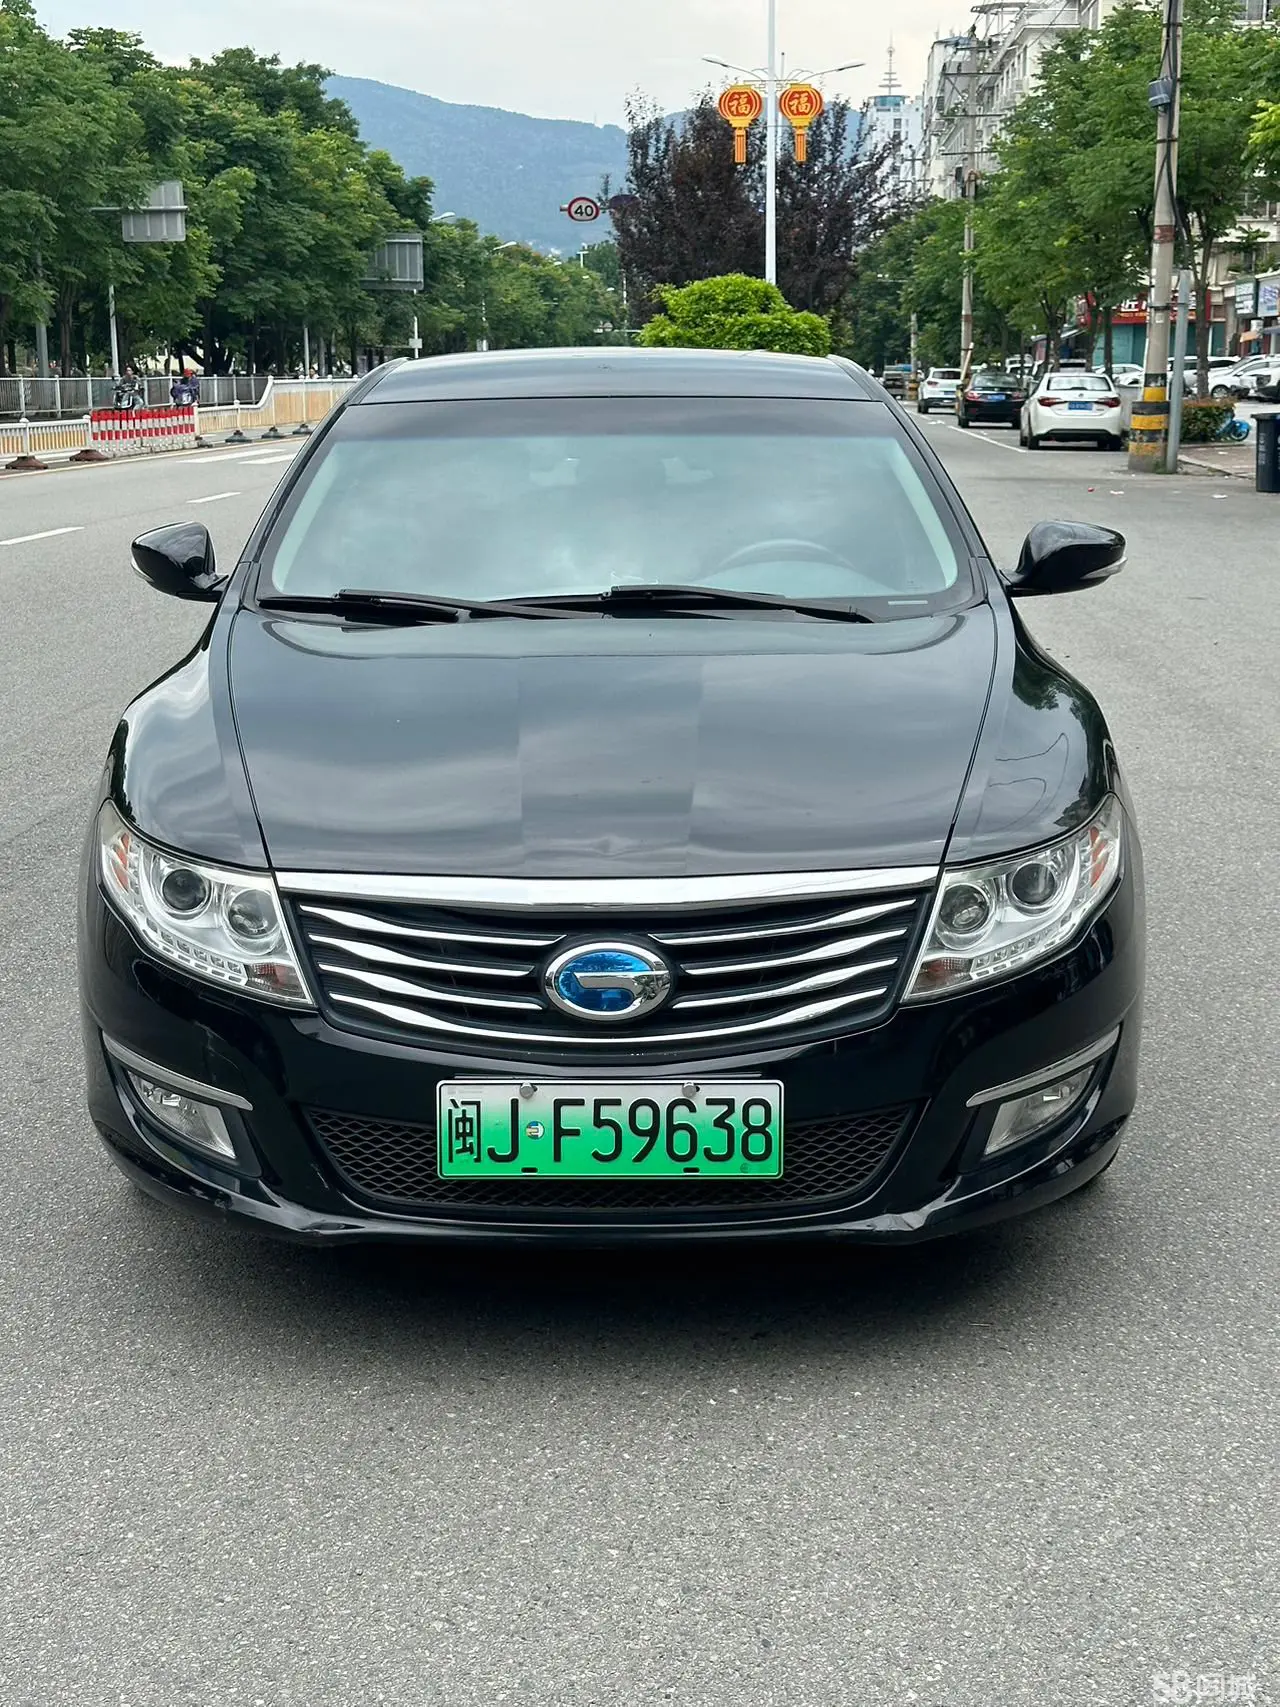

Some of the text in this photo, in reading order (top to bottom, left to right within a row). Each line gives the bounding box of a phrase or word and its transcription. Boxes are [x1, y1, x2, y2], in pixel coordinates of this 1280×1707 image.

[729, 93, 751, 115] 福
[788, 92, 811, 114] 福
[574, 205, 594, 217] 40
